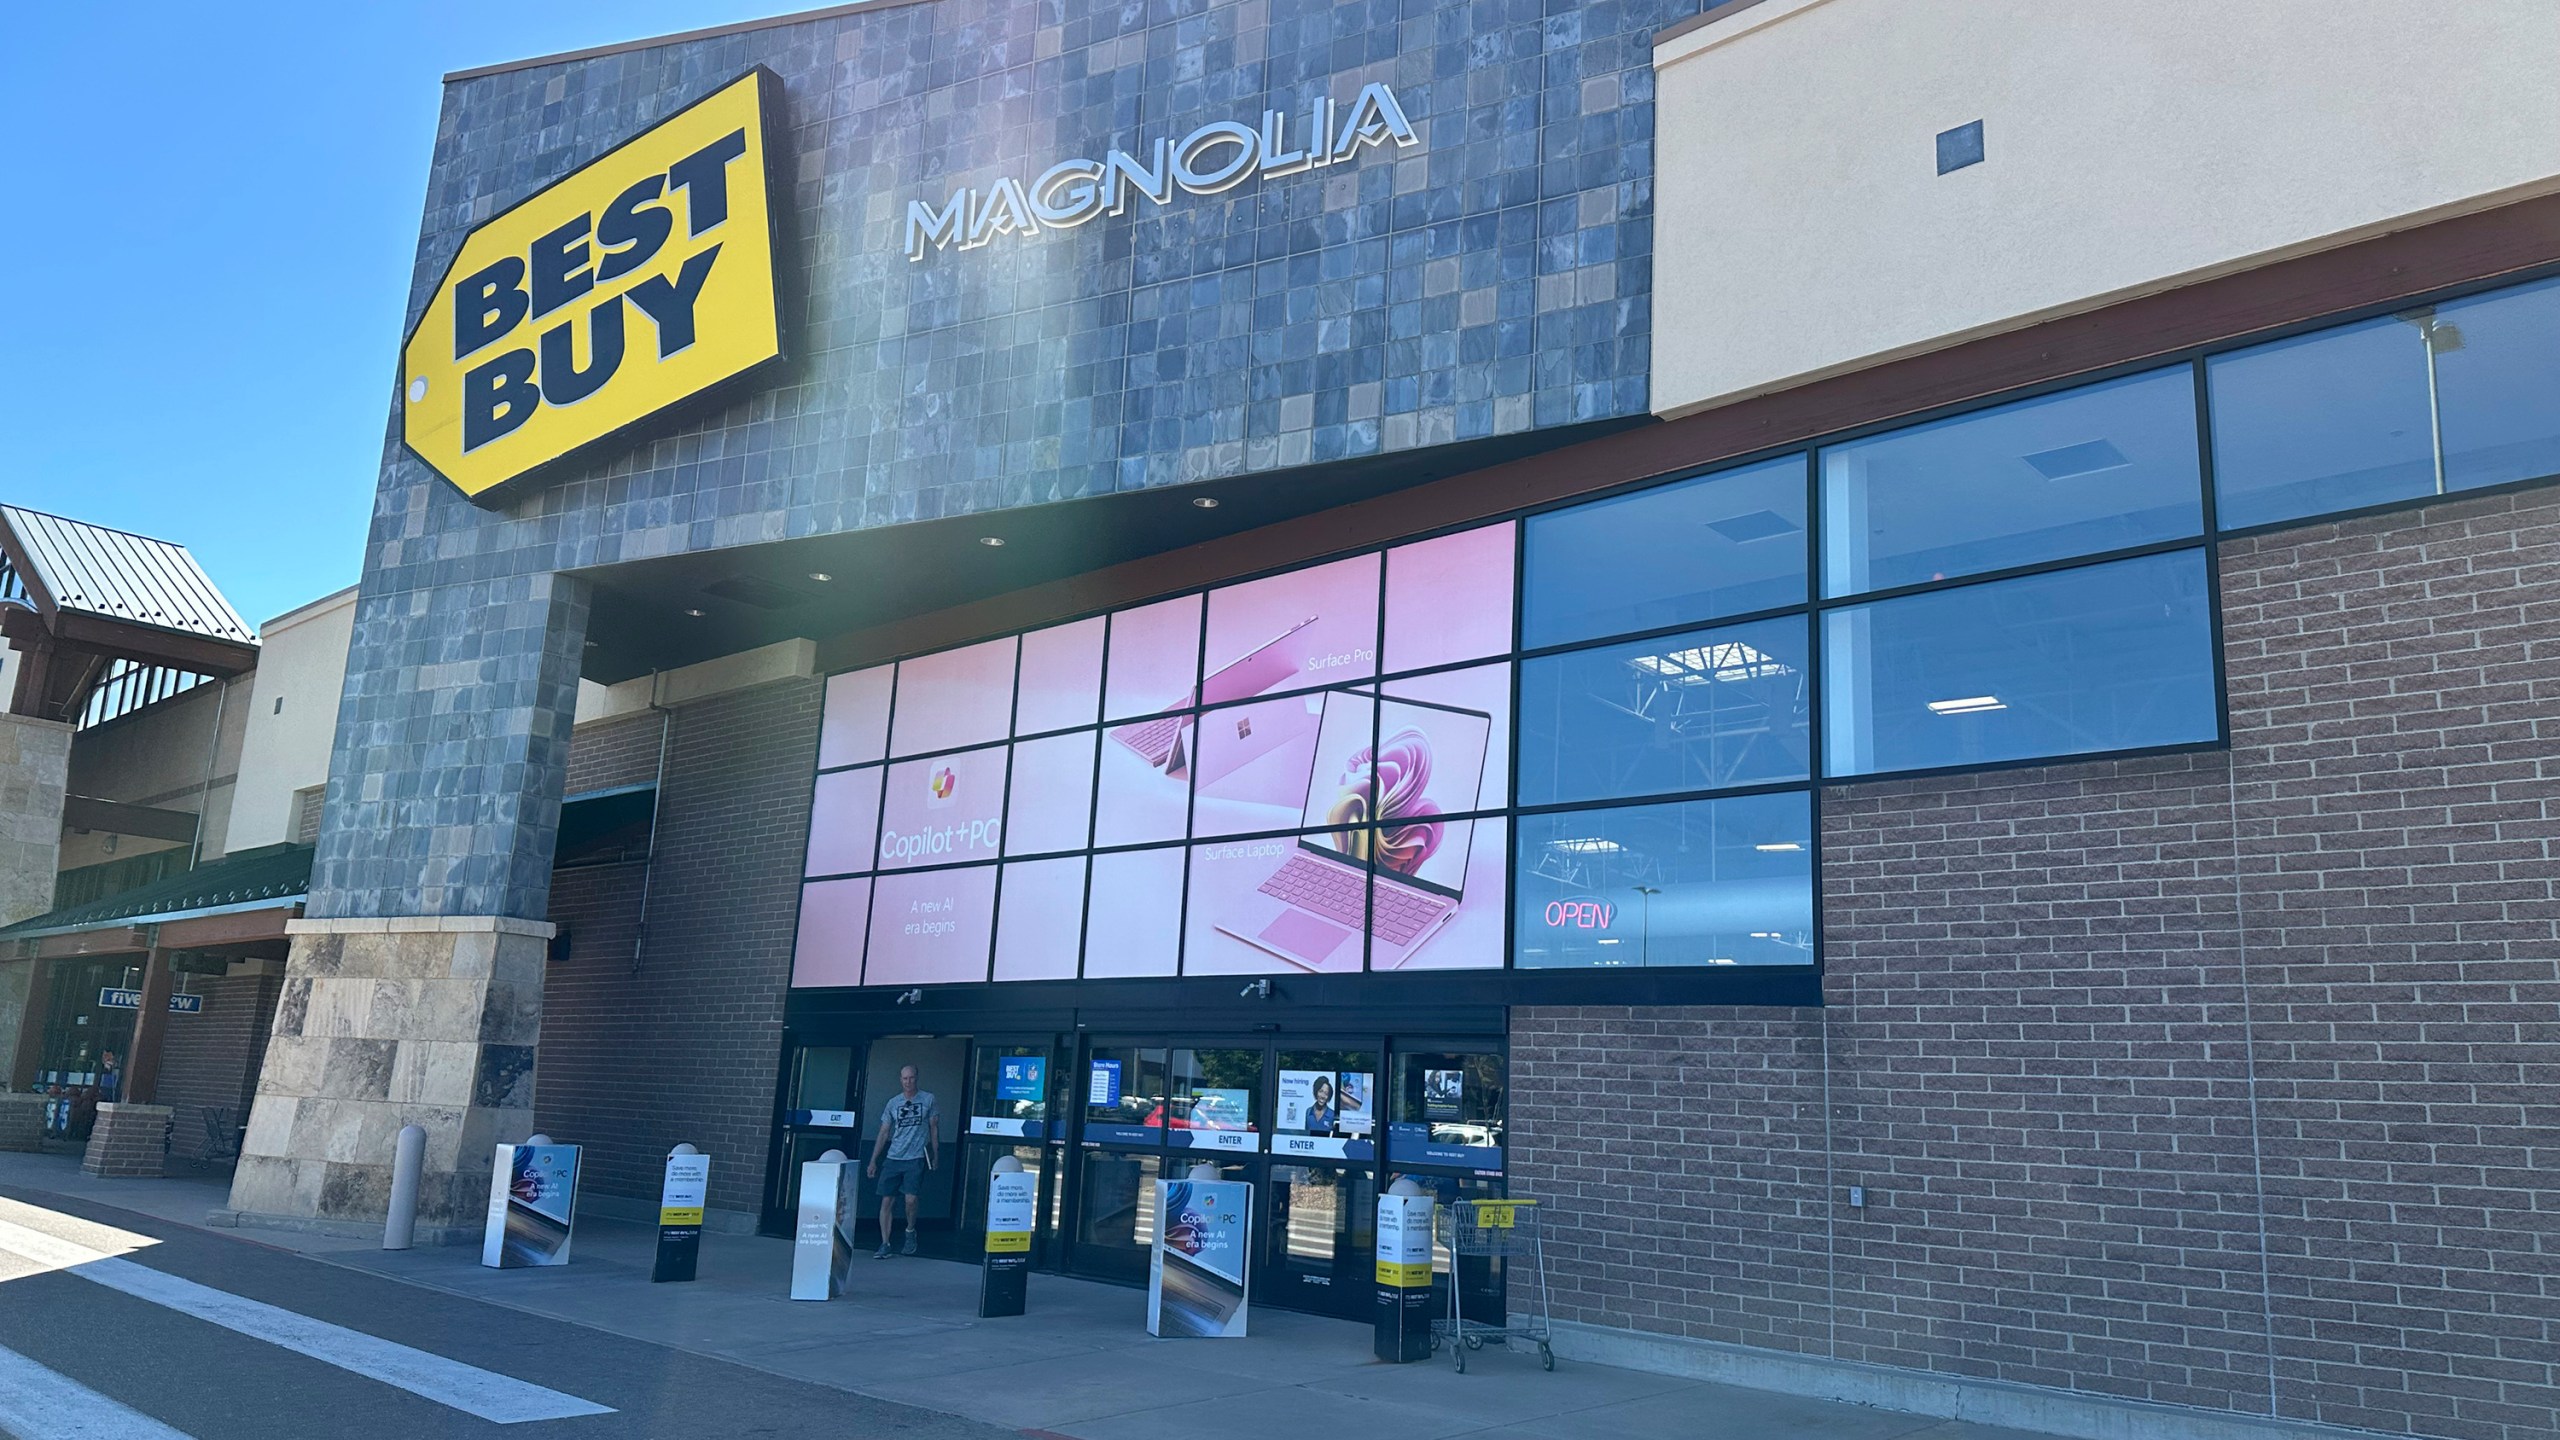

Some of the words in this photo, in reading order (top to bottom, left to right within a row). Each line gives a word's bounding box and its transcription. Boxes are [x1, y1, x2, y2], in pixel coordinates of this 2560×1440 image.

[904, 82, 1419, 262] MAGNOLIA
[453, 126, 746, 362] BEST
[462, 241, 724, 455] BUY
[1308, 652, 1350, 671] Surface
[1354, 649, 1373, 662] Pro
[1205, 845, 1245, 861] Surface
[1247, 842, 1285, 858] Laptop
[911, 900, 918, 914] A
[921, 902, 941, 913] new
[942, 897, 954, 911] AI
[1545, 901, 1610, 929] OPEN
[905, 922, 920, 935] era
[922, 919, 955, 936] begins
[111, 992, 141, 1006] five
[1294, 1078, 1309, 1086] hiring
[986, 1121, 999, 1129] EXIT
[1218, 1135, 1242, 1144] ENTER
[1289, 1140, 1314, 1150] ENTER
[1181, 1213, 1216, 1225] Copilo
[1190, 1230, 1196, 1238] A
[1216, 1230, 1225, 1238] AI
[1201, 1240, 1228, 1250] begins
